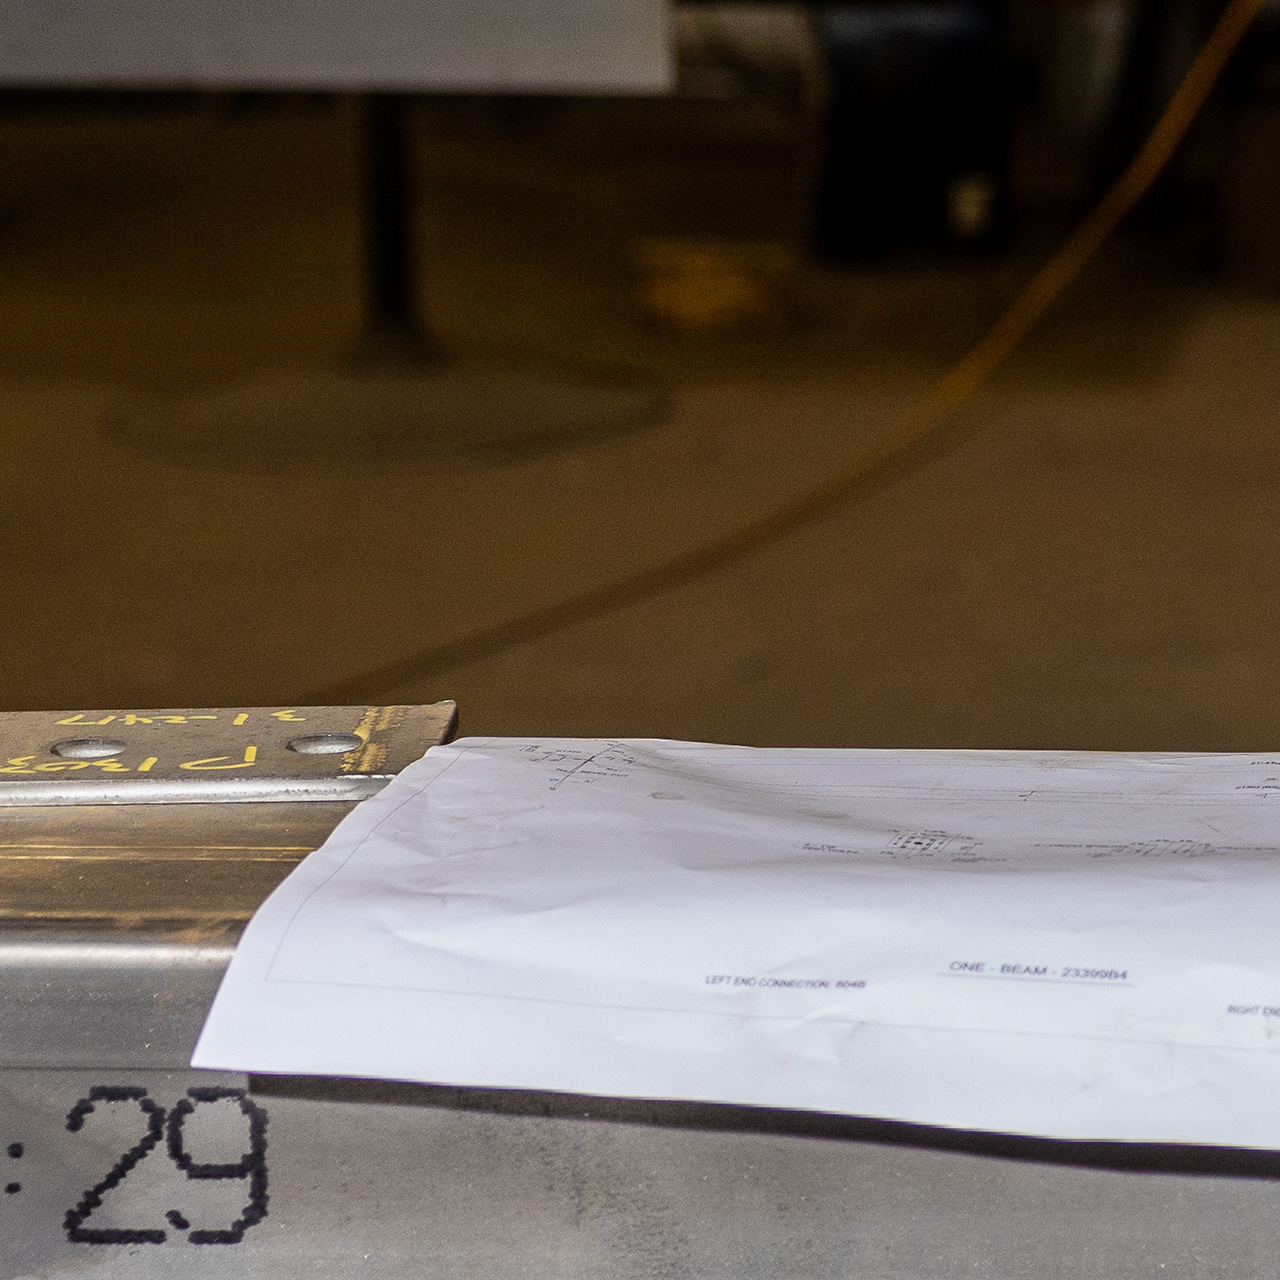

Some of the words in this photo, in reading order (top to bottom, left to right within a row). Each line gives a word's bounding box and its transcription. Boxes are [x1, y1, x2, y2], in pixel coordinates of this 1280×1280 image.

[950, 960, 986, 973] ONE
[1000, 963, 1048, 976] BEAM
[734, 976, 757, 987] END
[63, 1085, 269, 1244] 29
